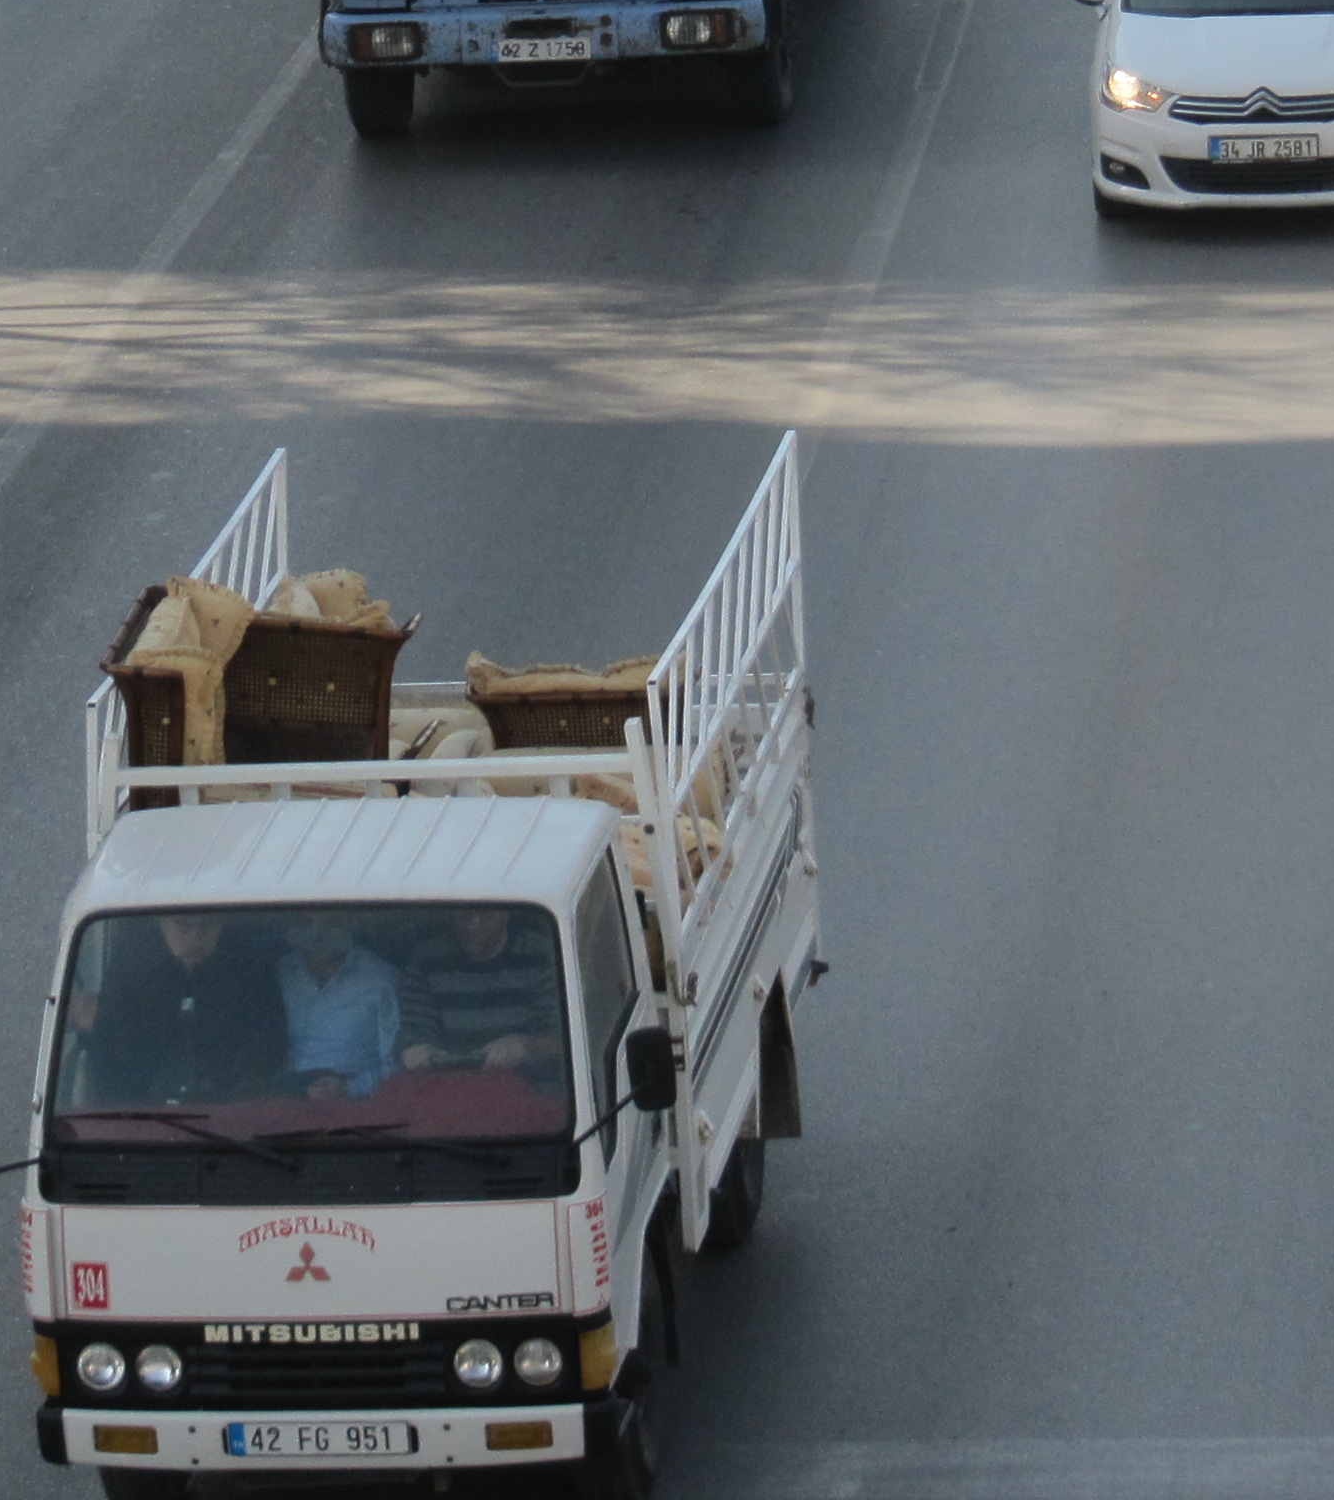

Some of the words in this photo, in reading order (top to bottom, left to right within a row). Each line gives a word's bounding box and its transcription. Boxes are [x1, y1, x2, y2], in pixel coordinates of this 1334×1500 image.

[528, 42, 540, 58] Z
[1220, 141, 1240, 158] 34
[1247, 141, 1266, 158] JR
[1273, 140, 1312, 157] 2581
[77, 1267, 106, 1303] 304
[446, 1291, 554, 1311] CANTER
[204, 1322, 420, 1344] MITSUBISHI
[250, 1426, 282, 1452] 42
[298, 1426, 330, 1451] FG
[346, 1425, 391, 1451] 951
